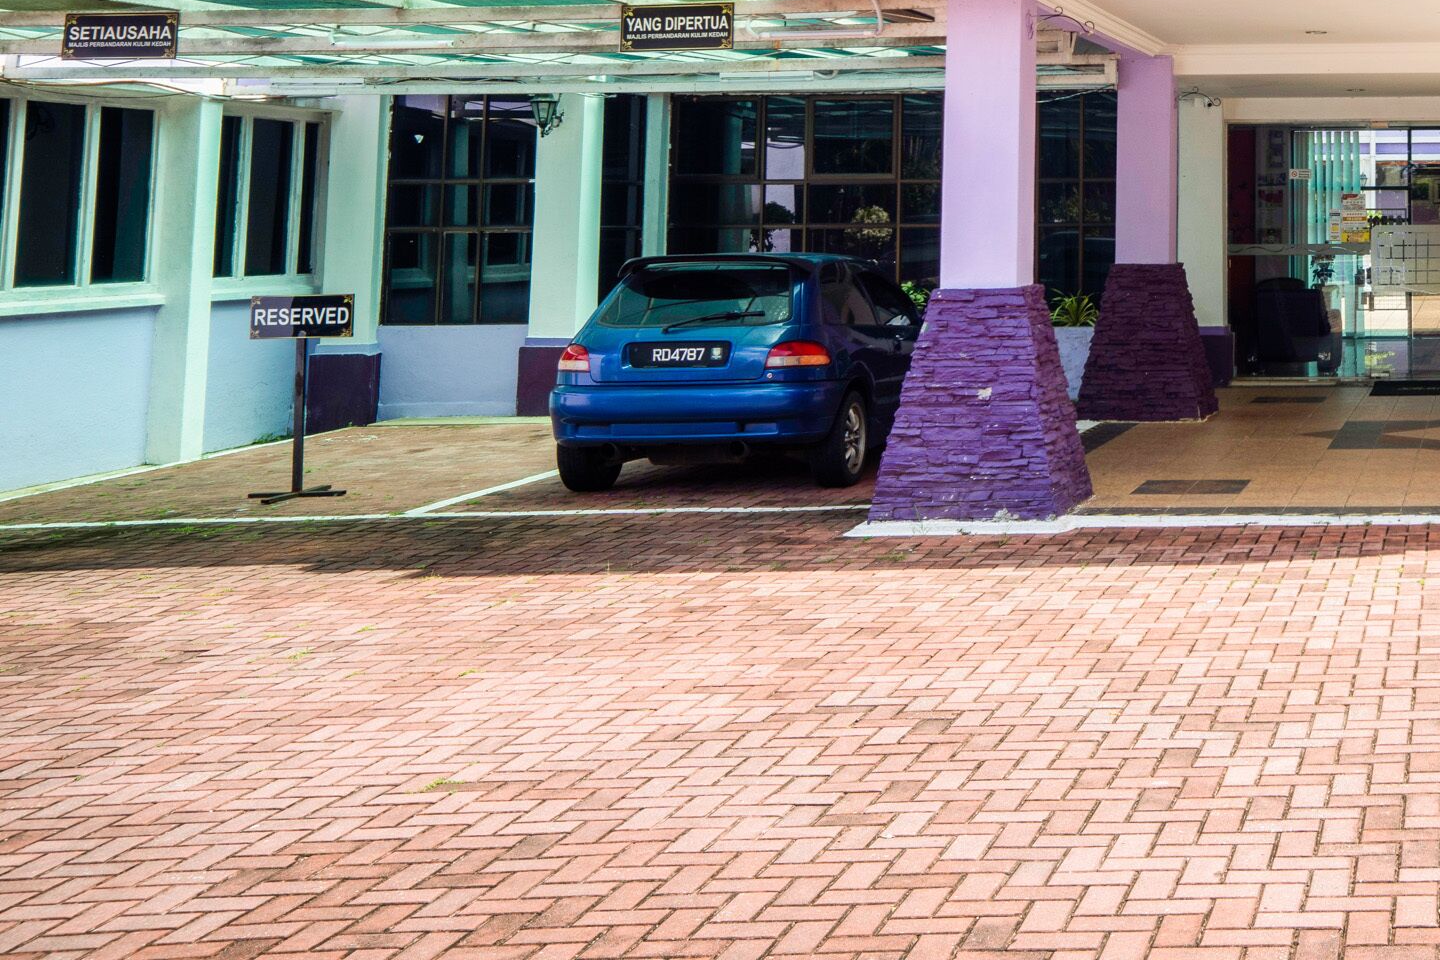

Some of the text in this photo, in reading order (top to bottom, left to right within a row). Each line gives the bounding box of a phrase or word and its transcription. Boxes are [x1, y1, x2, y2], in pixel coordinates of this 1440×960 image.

[626, 15, 729, 32] YANG DIPERTUA
[69, 25, 172, 41] SETIAUSAHA
[254, 306, 350, 326] RESERVED
[652, 347, 706, 362] RD4787
